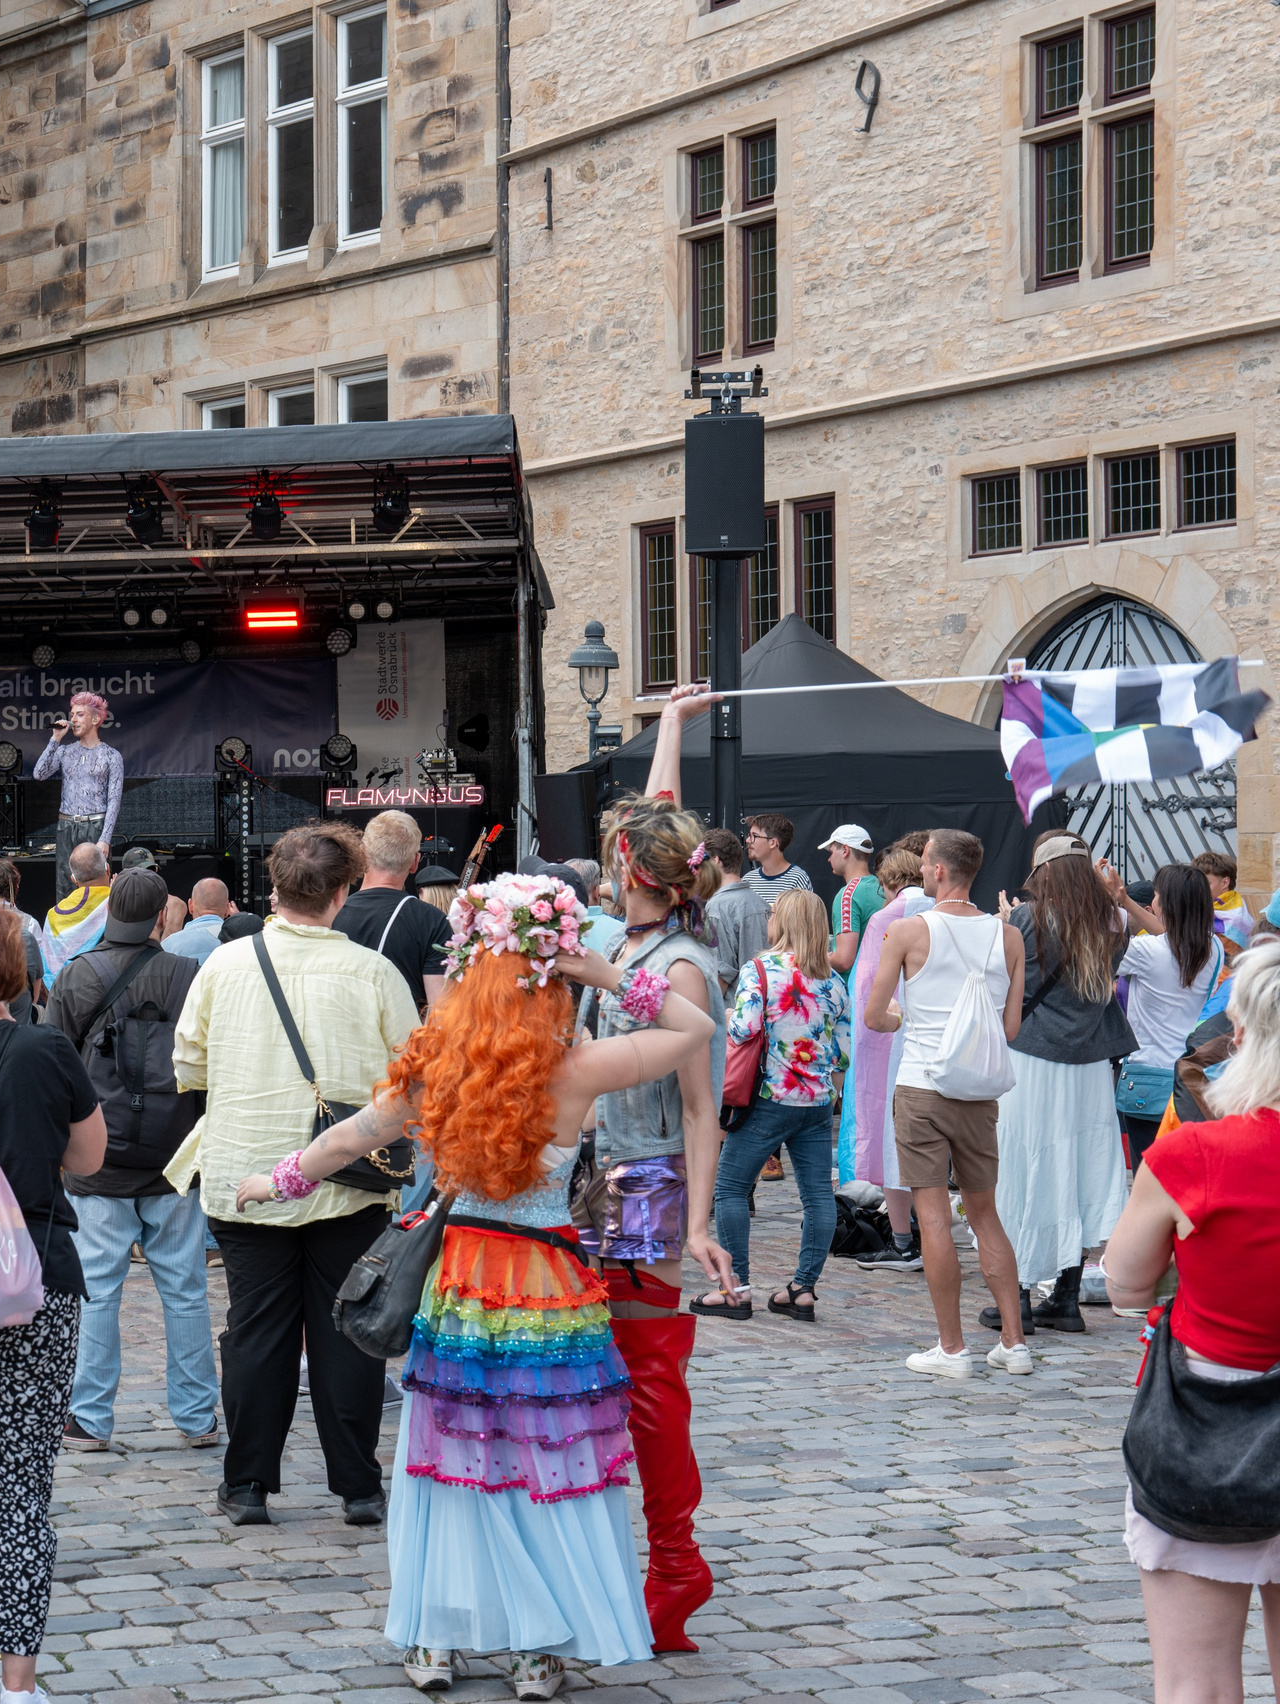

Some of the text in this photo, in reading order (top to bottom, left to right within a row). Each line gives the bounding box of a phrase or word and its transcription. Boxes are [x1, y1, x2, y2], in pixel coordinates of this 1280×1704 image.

[376, 631, 387, 695] Stadtwerke
[387, 631, 398, 695] Osnabrück
[40, 670, 156, 697] braucht
[1, 704, 122, 731] Stime.
[325, 785, 485, 808] FLAMYNGUS
